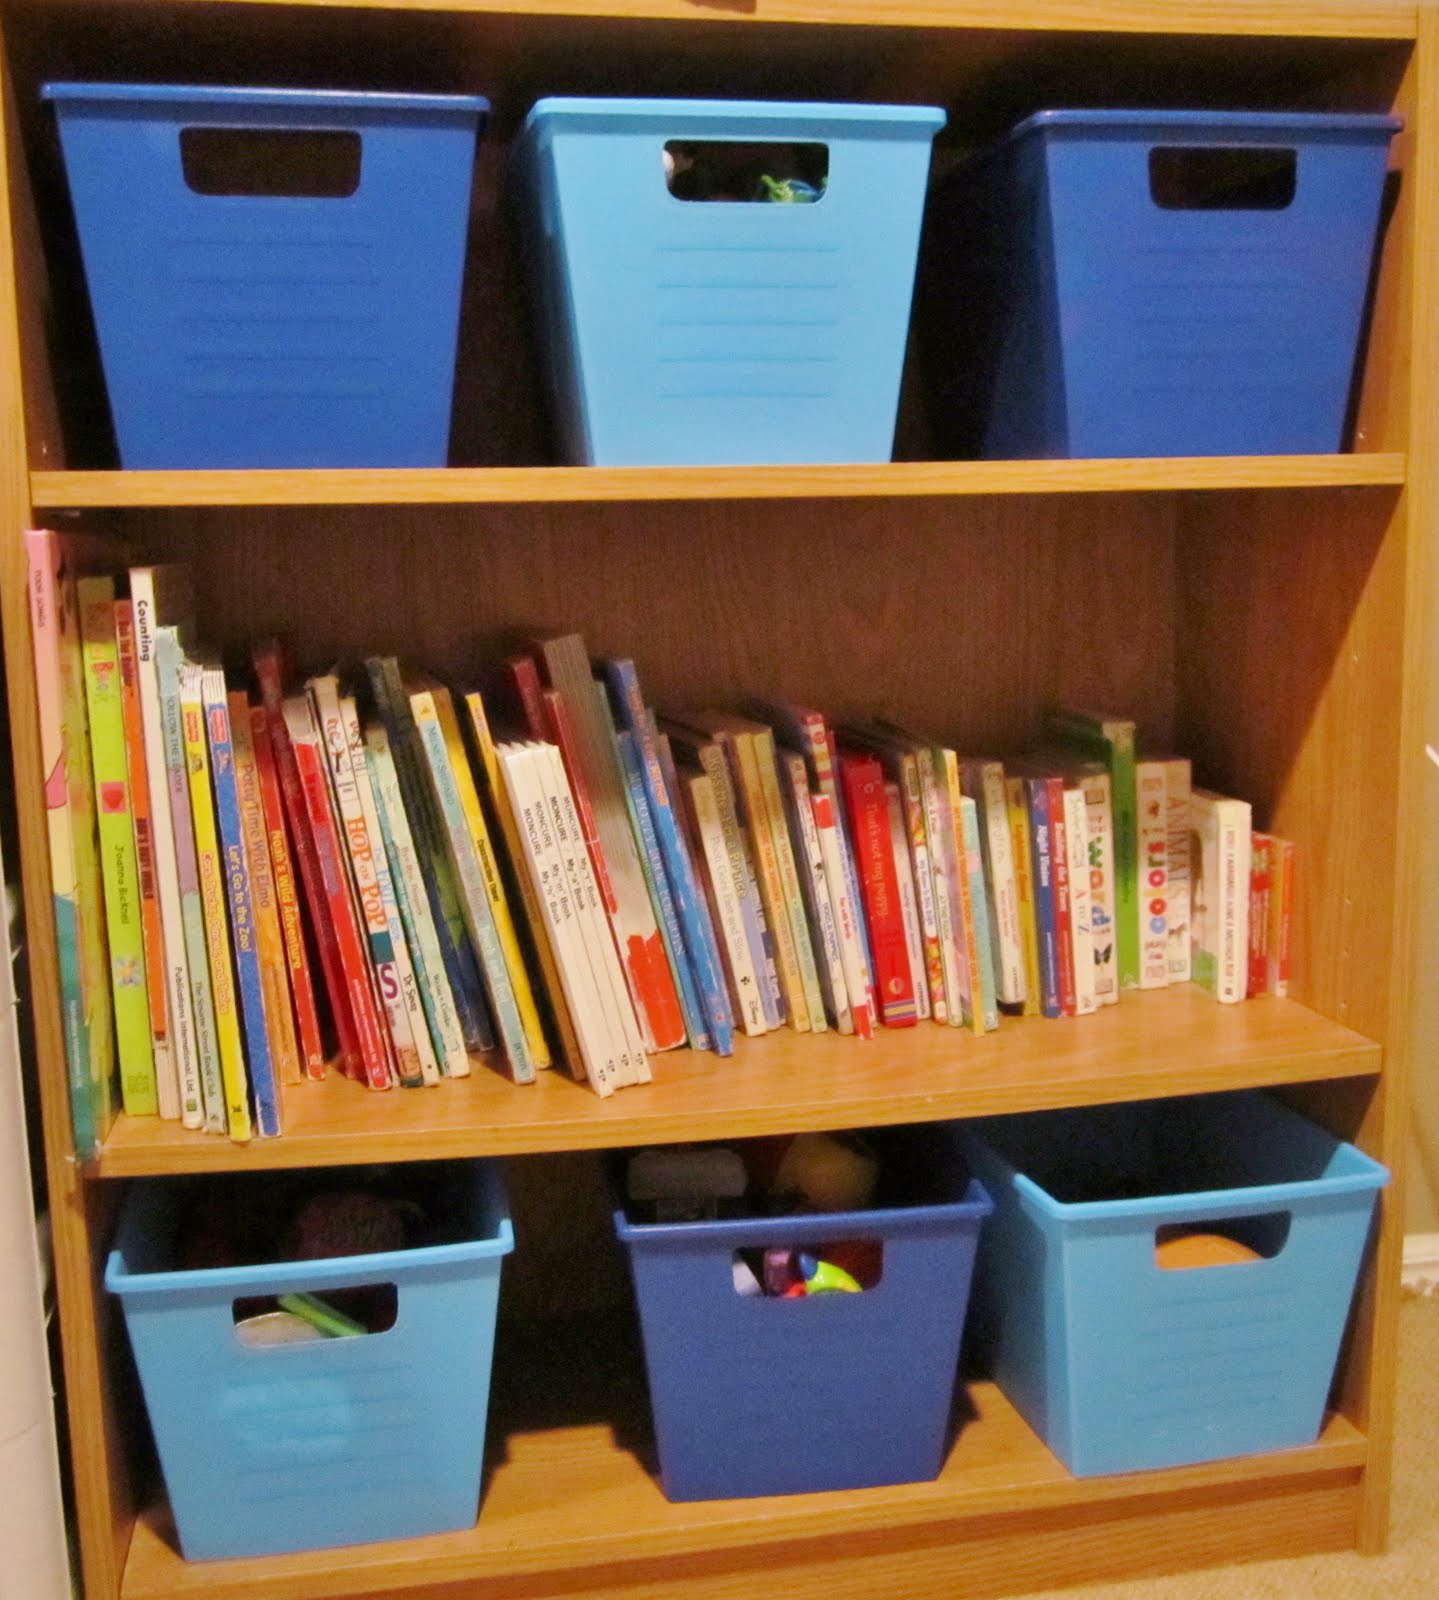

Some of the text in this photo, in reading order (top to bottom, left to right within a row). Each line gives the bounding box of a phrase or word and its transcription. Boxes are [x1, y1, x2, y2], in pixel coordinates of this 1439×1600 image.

[137, 600, 152, 662] Counting
[169, 738, 180, 760] THE
[170, 762, 183, 793] LEADER
[241, 764, 271, 908] Potty Time With Elmo
[865, 803, 882, 836] That's
[271, 829, 290, 872] Noah's
[534, 801, 553, 848] MONCURE
[551, 864, 560, 878] My
[560, 896, 572, 920] Book
[550, 796, 568, 842] MONCURE
[566, 858, 575, 872] My
[574, 888, 585, 912] Book
[563, 796, 581, 842] MONCURE
[579, 858, 588, 870] My
[586, 886, 598, 909] Book
[870, 839, 884, 860] not
[1036, 825, 1050, 886] Night Vision
[1054, 822, 1064, 864] Building
[114, 846, 127, 885] Joanna
[347, 816, 373, 863] HOP
[360, 882, 388, 926] POP
[524, 808, 543, 857] MONCURE
[541, 871, 550, 884] My
[550, 901, 561, 925] Book
[650, 848, 666, 886] BOOK
[659, 890, 674, 916] FOR
[872, 861, 884, 880] my
[1058, 867, 1066, 882] the
[227, 845, 250, 953] Let's Go to the Zoo!
[278, 876, 294, 902] Wild
[282, 906, 302, 969] Adventure
[728, 916, 740, 936] and
[213, 960, 226, 980] and
[732, 937, 744, 961] Slow
[174, 966, 187, 1018] Publications
[216, 982, 230, 1014] Trains
[405, 990, 418, 1012] Seuss
[748, 1000, 759, 1025] Disney
[194, 981, 217, 1098] The Sesame Street Book Club
